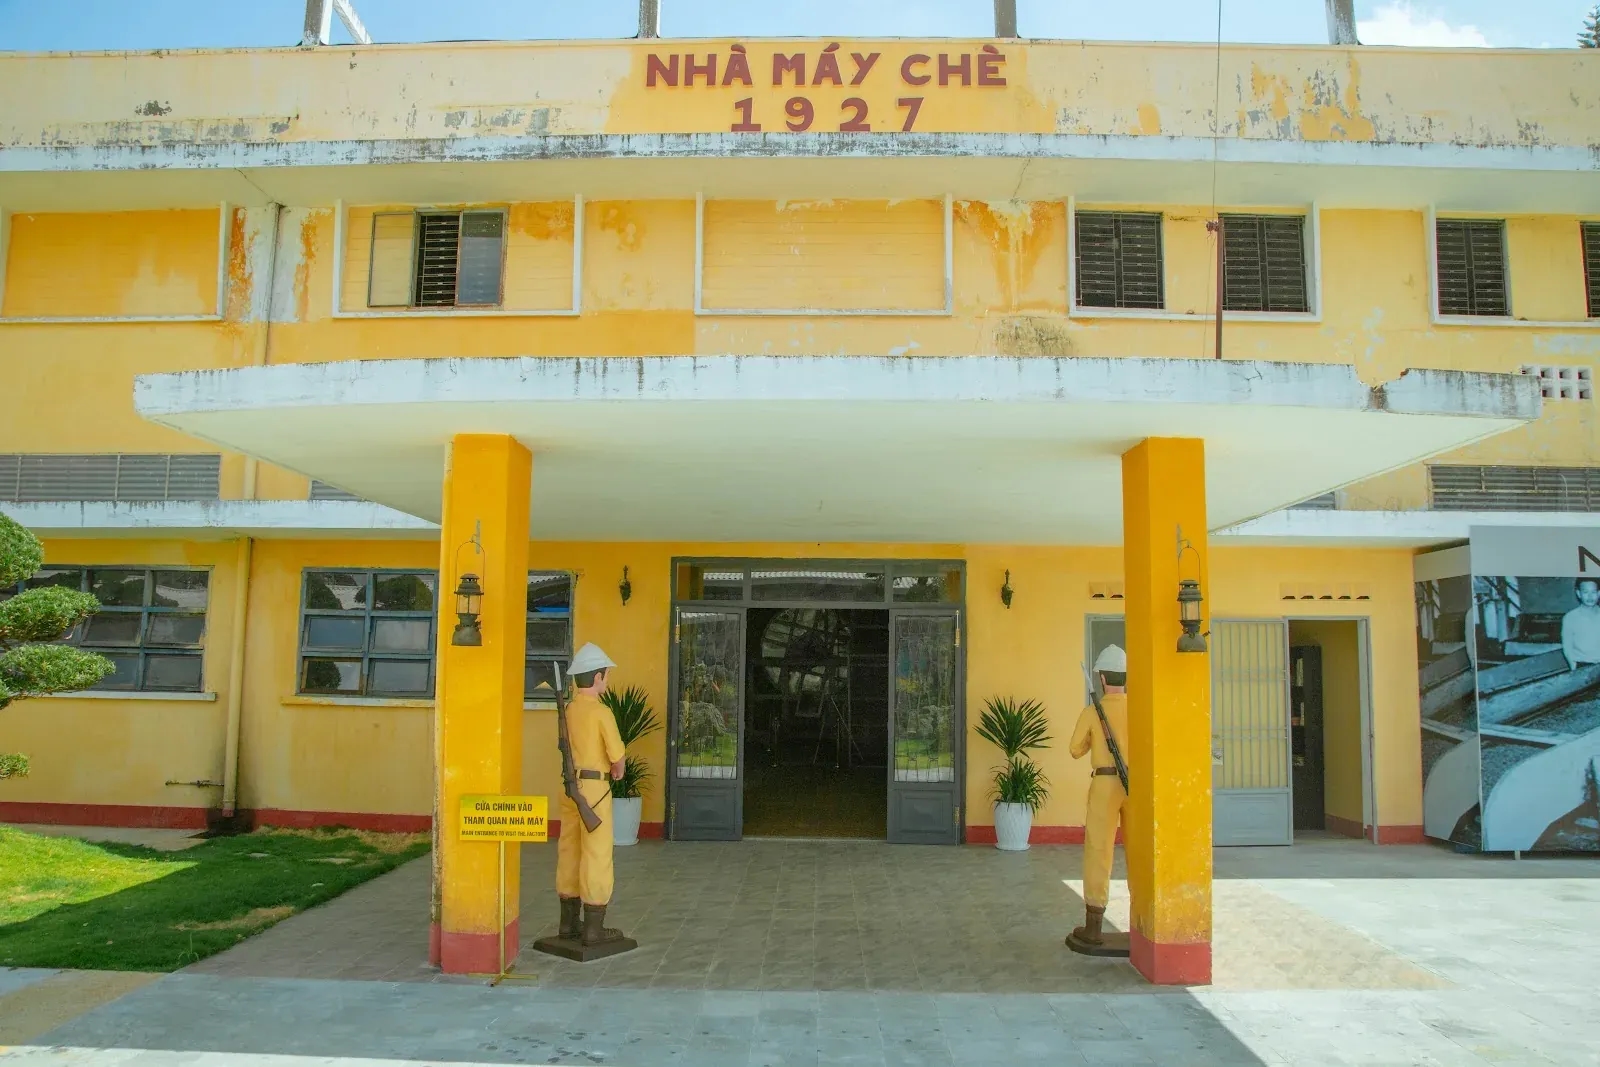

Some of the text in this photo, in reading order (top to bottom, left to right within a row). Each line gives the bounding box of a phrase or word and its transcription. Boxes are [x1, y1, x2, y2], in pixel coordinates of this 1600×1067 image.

[646, 42, 1007, 87] NHÀ MÁY CHÈ
[475, 800, 533, 812] CỬA CHÍNH VÀO
[464, 816, 544, 826] THAM QUAN NHÀ MÁY
